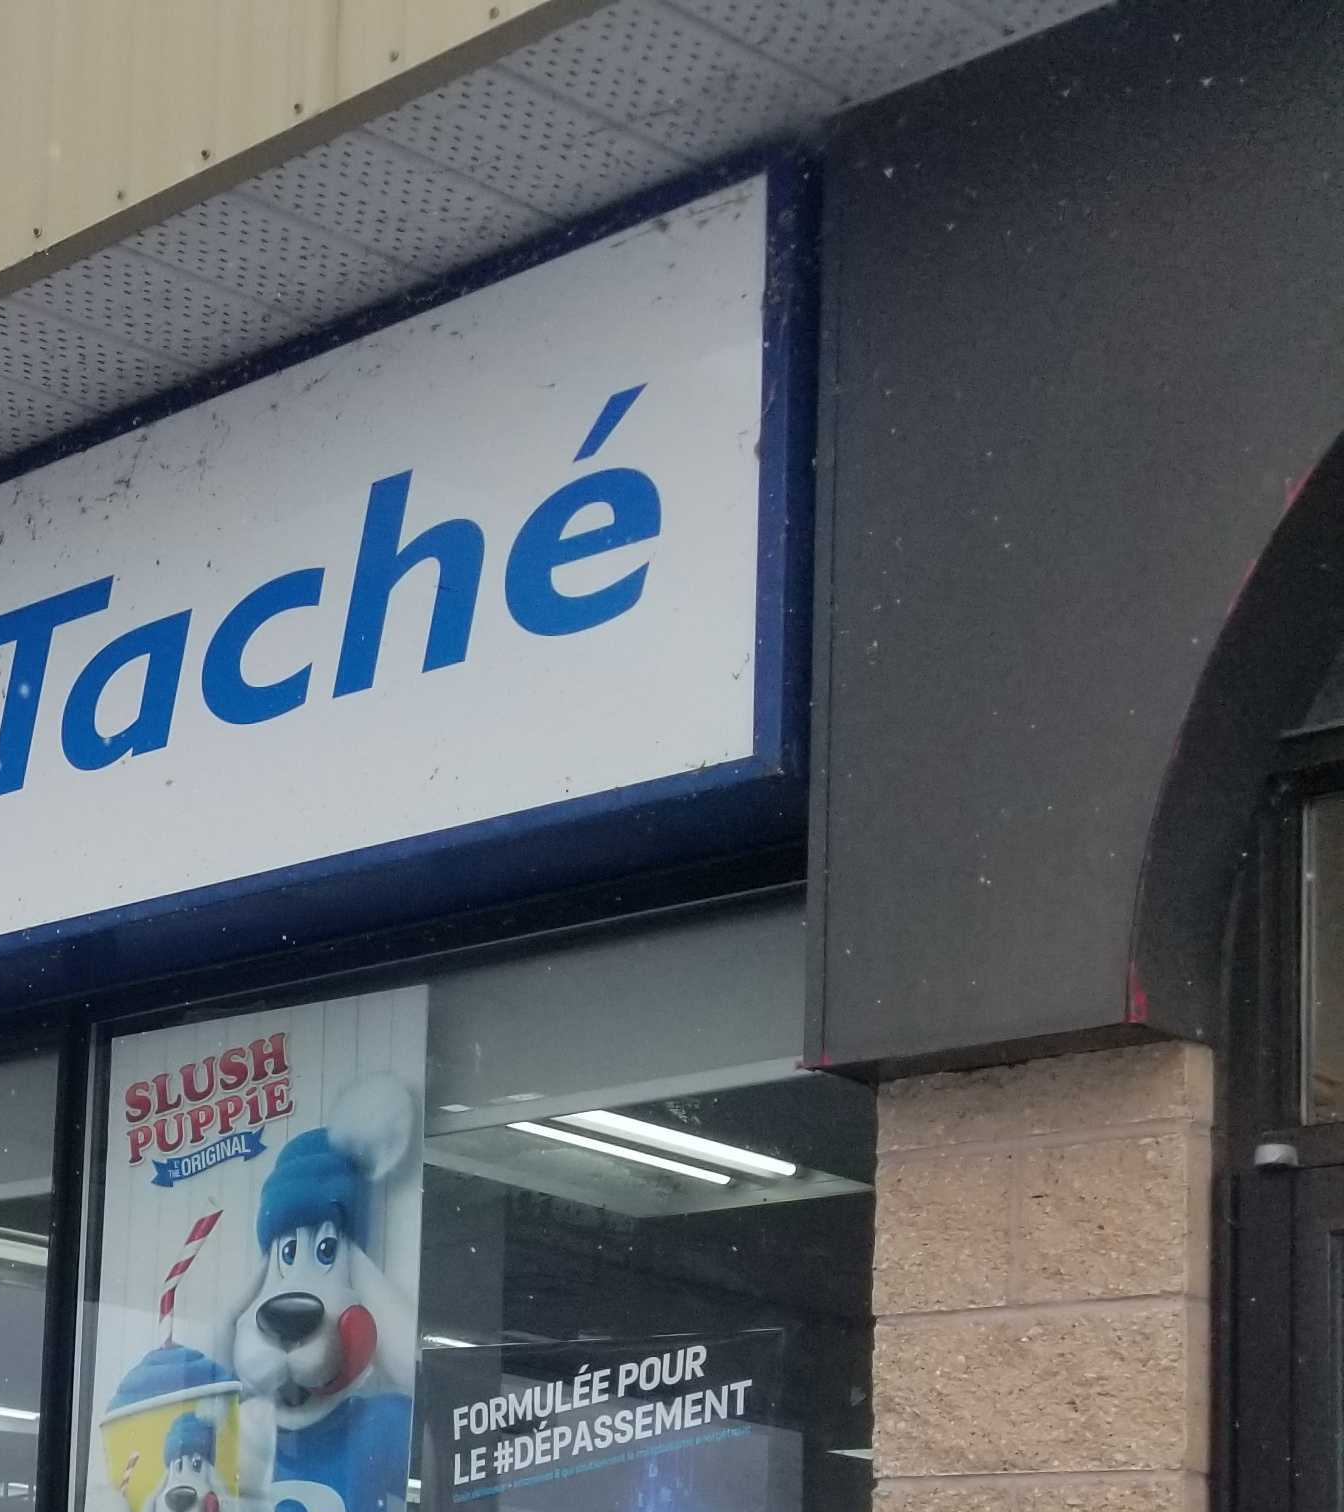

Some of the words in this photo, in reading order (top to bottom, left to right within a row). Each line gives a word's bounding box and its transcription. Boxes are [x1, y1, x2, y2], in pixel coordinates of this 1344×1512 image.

[125, 1032, 289, 1123] SLUSH
[181, 1134, 251, 1176] ORIGINAL
[453, 1364, 611, 1441] FORMULÉE
[617, 1345, 707, 1398] POUR
[454, 1447, 487, 1486] LE
[493, 1379, 753, 1475] #DÉPASSEMENT
